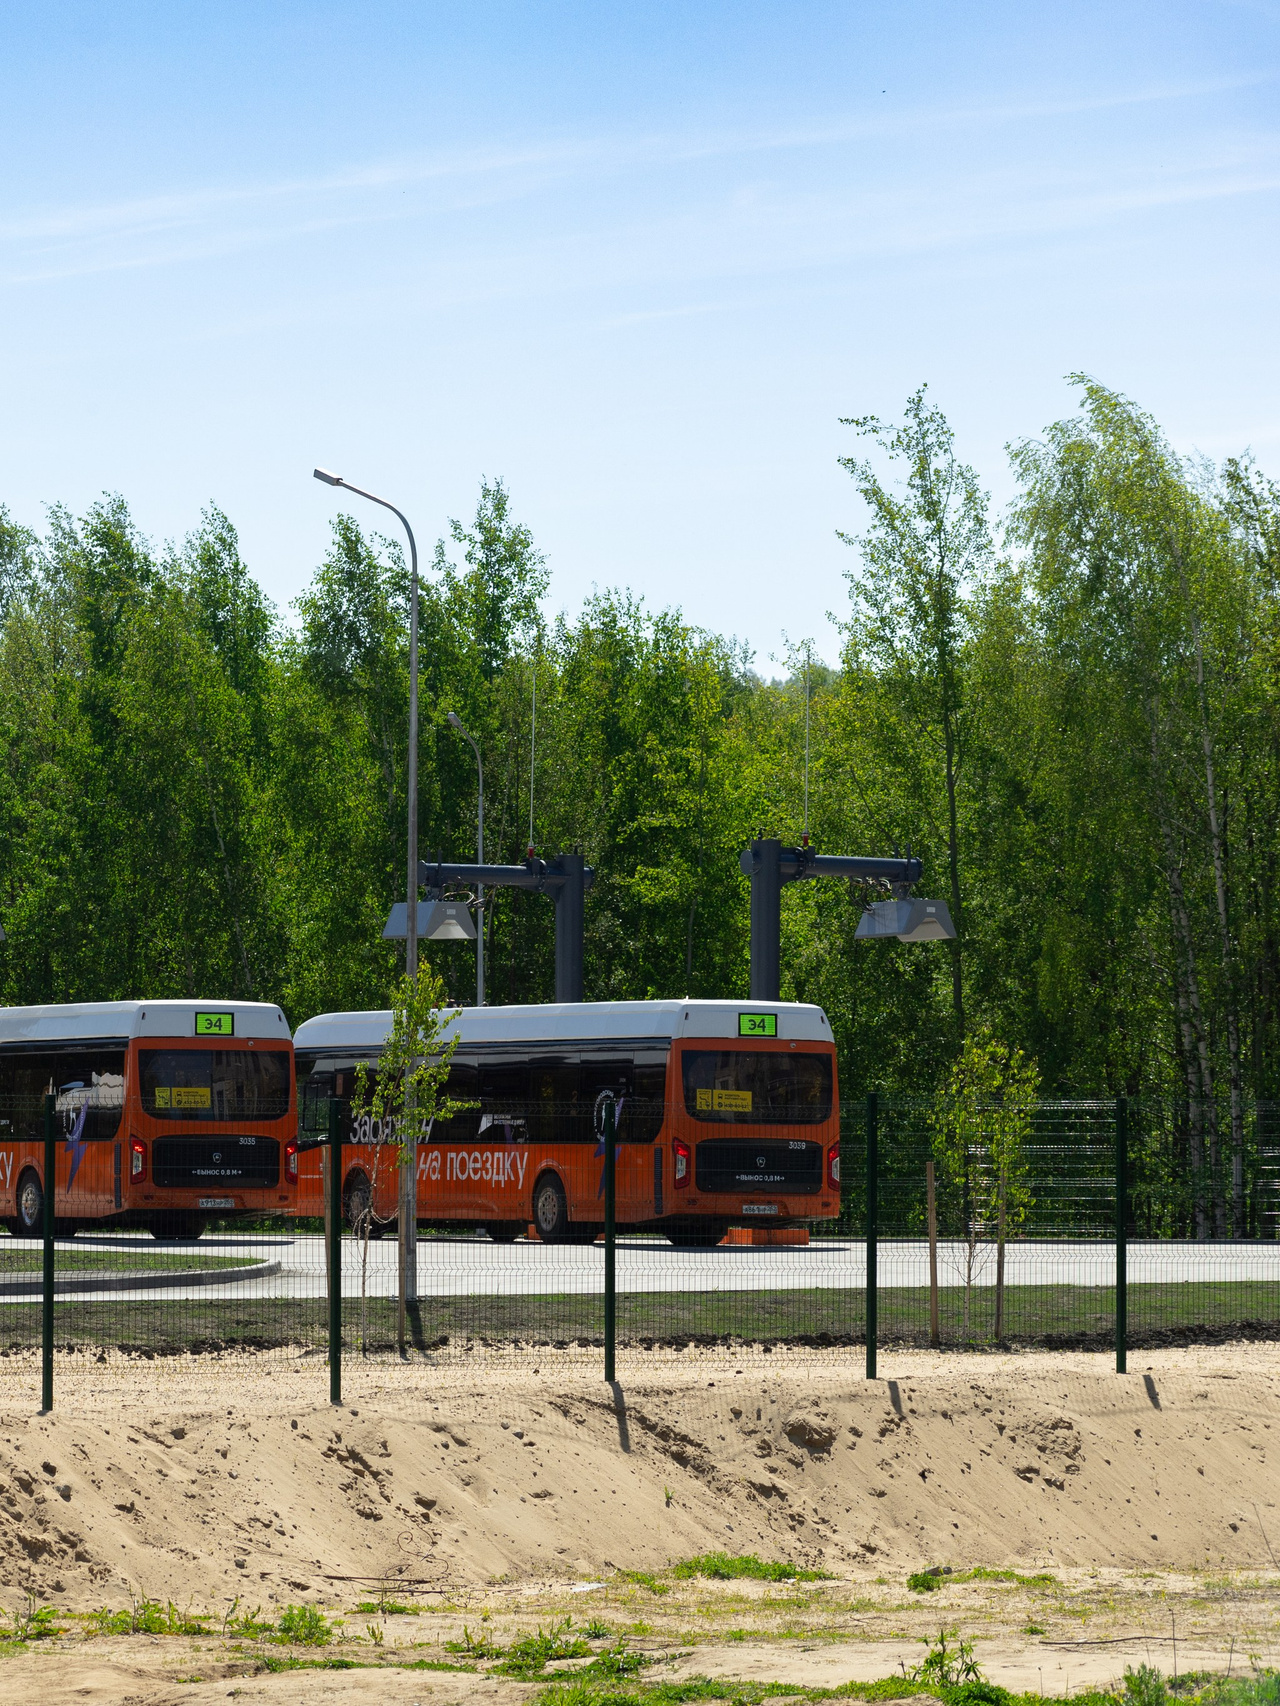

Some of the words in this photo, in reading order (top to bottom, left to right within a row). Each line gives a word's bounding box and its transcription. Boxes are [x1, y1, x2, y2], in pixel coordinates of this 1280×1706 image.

[238, 1137, 256, 1145] 3035
[416, 1150, 442, 1181] на
[446, 1151, 529, 1190] поездку
